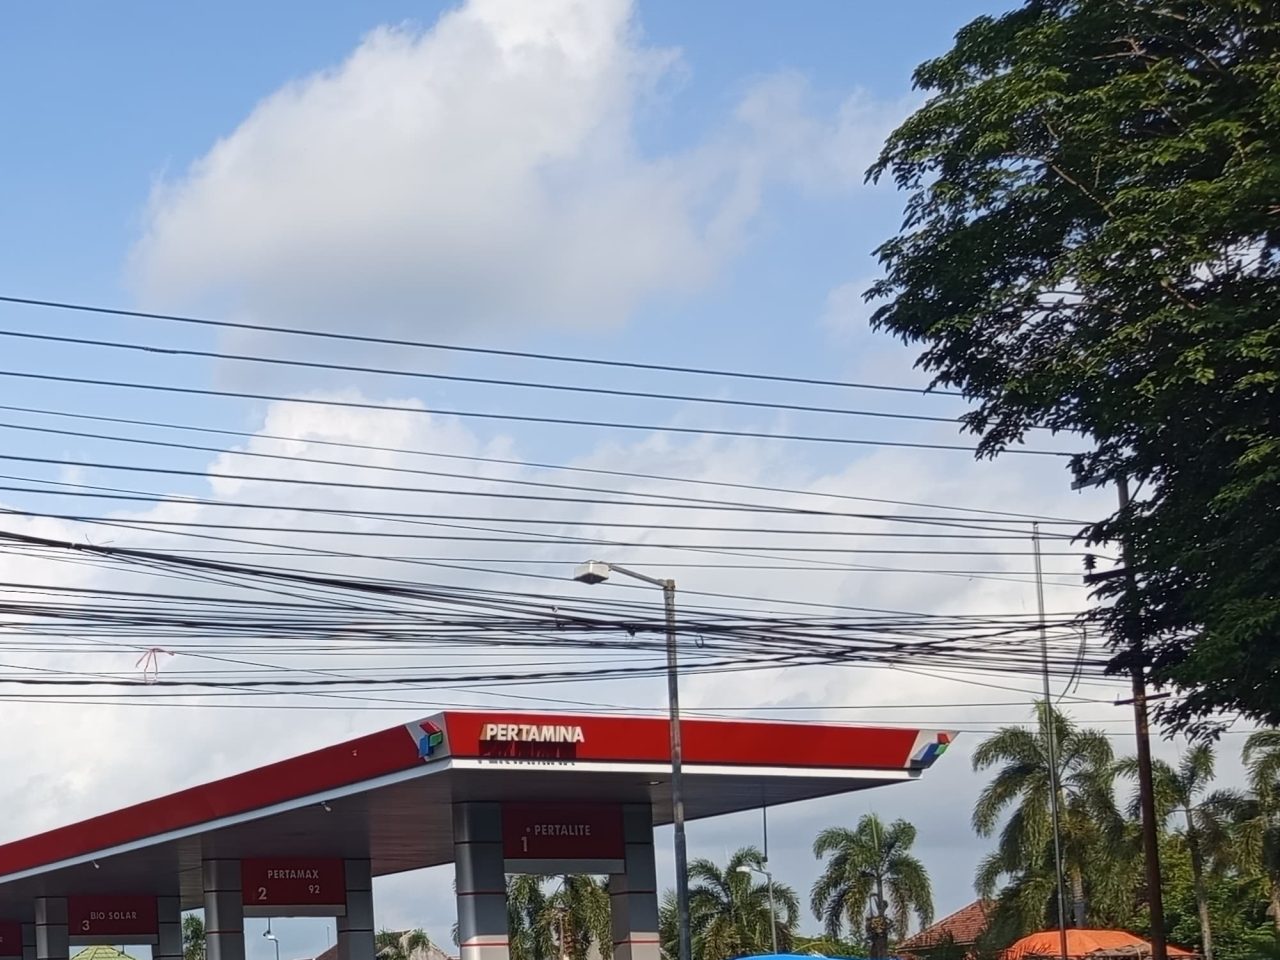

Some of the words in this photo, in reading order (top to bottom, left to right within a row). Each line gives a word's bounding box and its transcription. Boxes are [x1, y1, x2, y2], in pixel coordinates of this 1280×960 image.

[486, 723, 585, 743] PERTAMINA
[534, 824, 591, 836] PERTALITE
[521, 836, 528, 852] 1
[267, 869, 319, 879] PERTAMAX
[258, 887, 267, 900] 2
[308, 884, 321, 894] 92
[90, 911, 106, 920] BIO
[108, 911, 137, 920] SOLAR
[82, 920, 90, 931] 3
